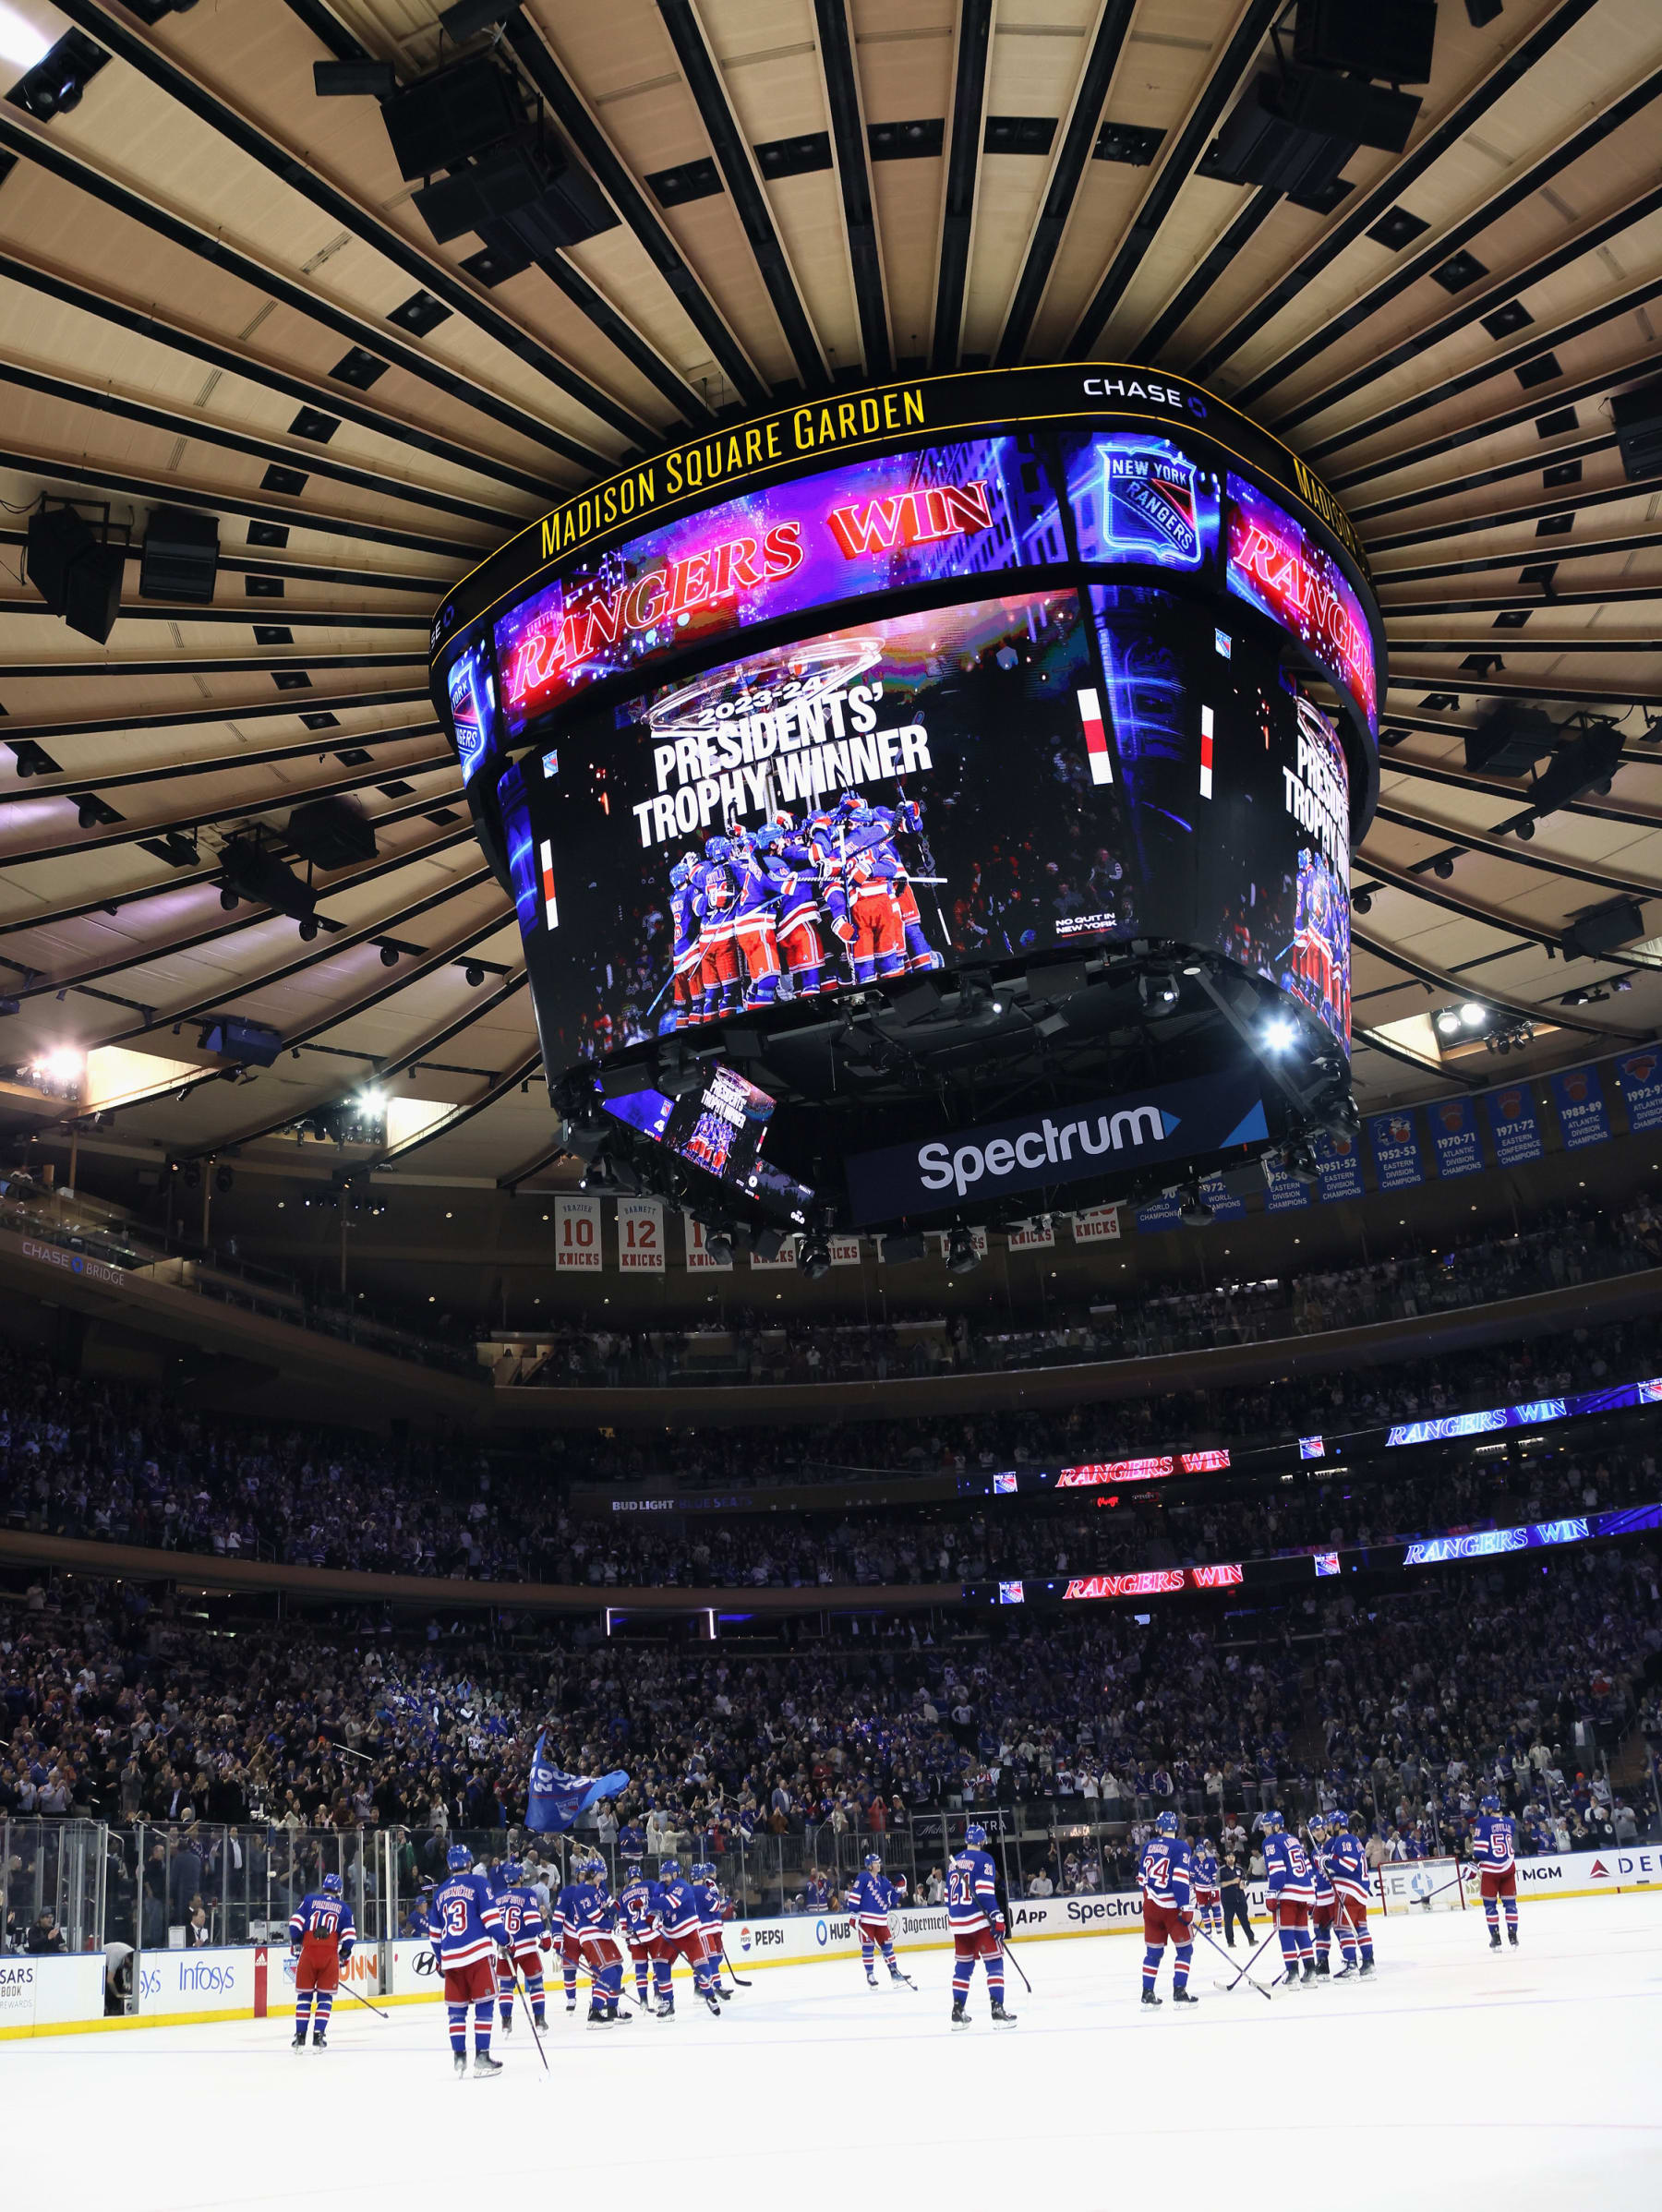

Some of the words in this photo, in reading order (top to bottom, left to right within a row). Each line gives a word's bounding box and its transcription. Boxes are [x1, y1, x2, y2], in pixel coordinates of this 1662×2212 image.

[1083, 379, 1183, 408] CHASE
[541, 468, 656, 559] MADISON
[666, 421, 782, 494] SQUARE
[793, 389, 925, 451] GARDEN
[1113, 459, 1149, 475] NEW
[1153, 463, 1186, 485] YORK
[1294, 458, 1357, 555] MADISON
[1126, 481, 1193, 550] RANGERS
[511, 521, 805, 704] RANGERS
[827, 479, 995, 560] WIN
[697, 676, 825, 727] 2023-24
[632, 761, 768, 848] TROPHY
[776, 724, 933, 803] WINNER
[1055, 919, 1073, 927] NO
[1074, 914, 1102, 923] QUIT
[1103, 912, 1115, 920] IN
[1055, 924, 1082, 934] NEW
[1084, 920, 1117, 930] YORK
[1561, 1100, 1603, 1120] 1988-89
[654, 1119, 666, 1133] 4
[1496, 1119, 1535, 1137] 1971-72
[1568, 1114, 1600, 1129] ATLANTIC
[1572, 1124, 1600, 1137] DIVISION
[1437, 1132, 1475, 1148] 1970-71
[1502, 1134, 1533, 1147] EASTERN
[1567, 1131, 1608, 1147] CHAMPIONS
[918, 1106, 1164, 1196] Spectrum
[1378, 1146, 1416, 1161] 1952-53
[1442, 1147, 1475, 1158] ATLANTIC
[1497, 1139, 1542, 1157] CONFERENCE
[1501, 1148, 1540, 1164] CHAMPIONS
[1383, 1160, 1414, 1171] EASTERN
[1441, 1161, 1482, 1176] CHAMPIONS
[1446, 1155, 1475, 1167] DIVISION
[1324, 1172, 1354, 1183] EASTERN
[1382, 1175, 1421, 1188] CHAMPIONS
[1386, 1168, 1415, 1179] DIVISION
[1322, 1187, 1361, 1200] CHAMPIONS
[1327, 1181, 1355, 1191] DIVISION
[1269, 1198, 1307, 1209] CHAMPIONS
[1272, 1190, 1300, 1201] DIVISION
[563, 1205, 593, 1213] FRAZIER
[624, 1206, 657, 1215] BARNETT
[563, 1219, 593, 1247] 10
[626, 1220, 656, 1248] 12
[693, 1220, 703, 1247] 1
[1011, 1229, 1052, 1244] KNICKS
[1076, 1220, 1117, 1238] KNICKS
[22, 1242, 70, 1268] CHASE
[86, 1262, 125, 1286] BRIDGE
[559, 1253, 599, 1266] KNICKS
[621, 1253, 662, 1268] KNICKS
[1385, 1408, 1508, 1447] RANGERS
[1515, 1398, 1568, 1425] WIN
[1054, 1456, 1174, 1488] RANGERS
[1181, 1449, 1231, 1474] WIN
[612, 1501, 638, 1511] BUD
[639, 1500, 674, 1510] LIGHT
[1403, 1526, 1529, 1566] RANGERS
[1536, 1518, 1590, 1545] WIN
[1062, 1569, 1186, 1600] RANGERS
[1192, 1564, 1244, 1588] WIN
[1143, 1856, 1171, 1889] 24
[950, 1873, 972, 1905] 21
[442, 1899, 468, 1940] 13
[1067, 1899, 1142, 1924] Spectru
[755, 1929, 784, 1946] PEPSI
[179, 1960, 235, 1994] Infosys
